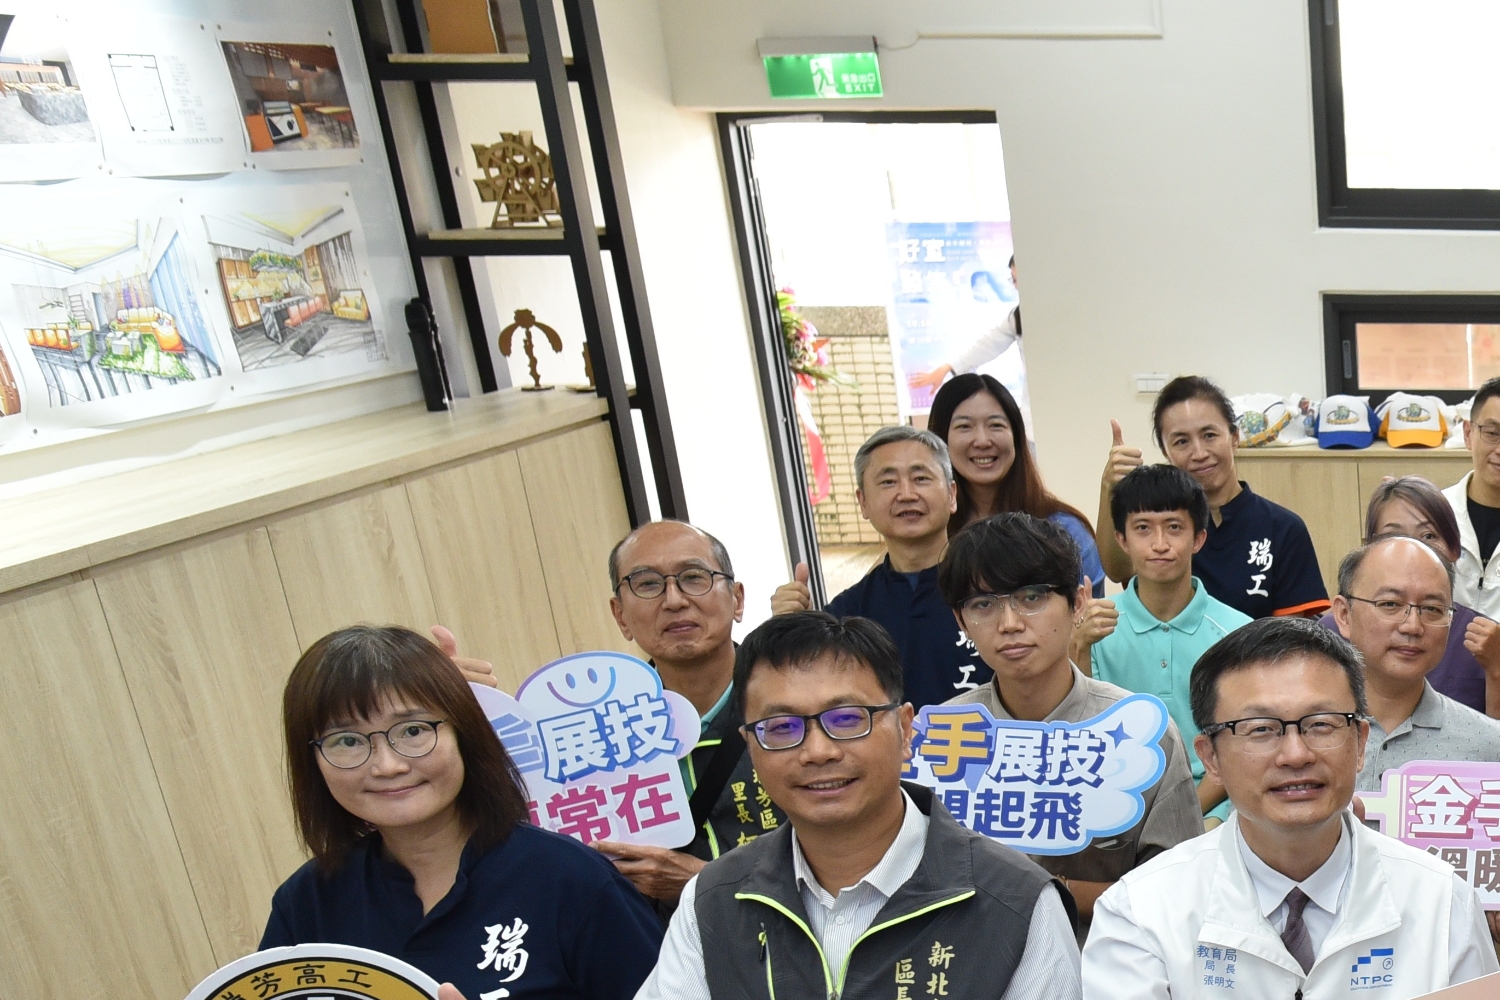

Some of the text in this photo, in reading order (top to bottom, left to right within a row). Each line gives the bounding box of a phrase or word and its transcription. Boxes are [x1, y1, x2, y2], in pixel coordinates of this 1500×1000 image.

[845, 83, 875, 93] EXIT
[1246, 538, 1273, 598] 瑞工
[902, 708, 1107, 786] 手展技
[731, 781, 754, 823] 里長
[1197, 945, 1237, 962] 教育局
[1203, 975, 1235, 989] 張明文
[1350, 974, 1393, 986] NTPC
